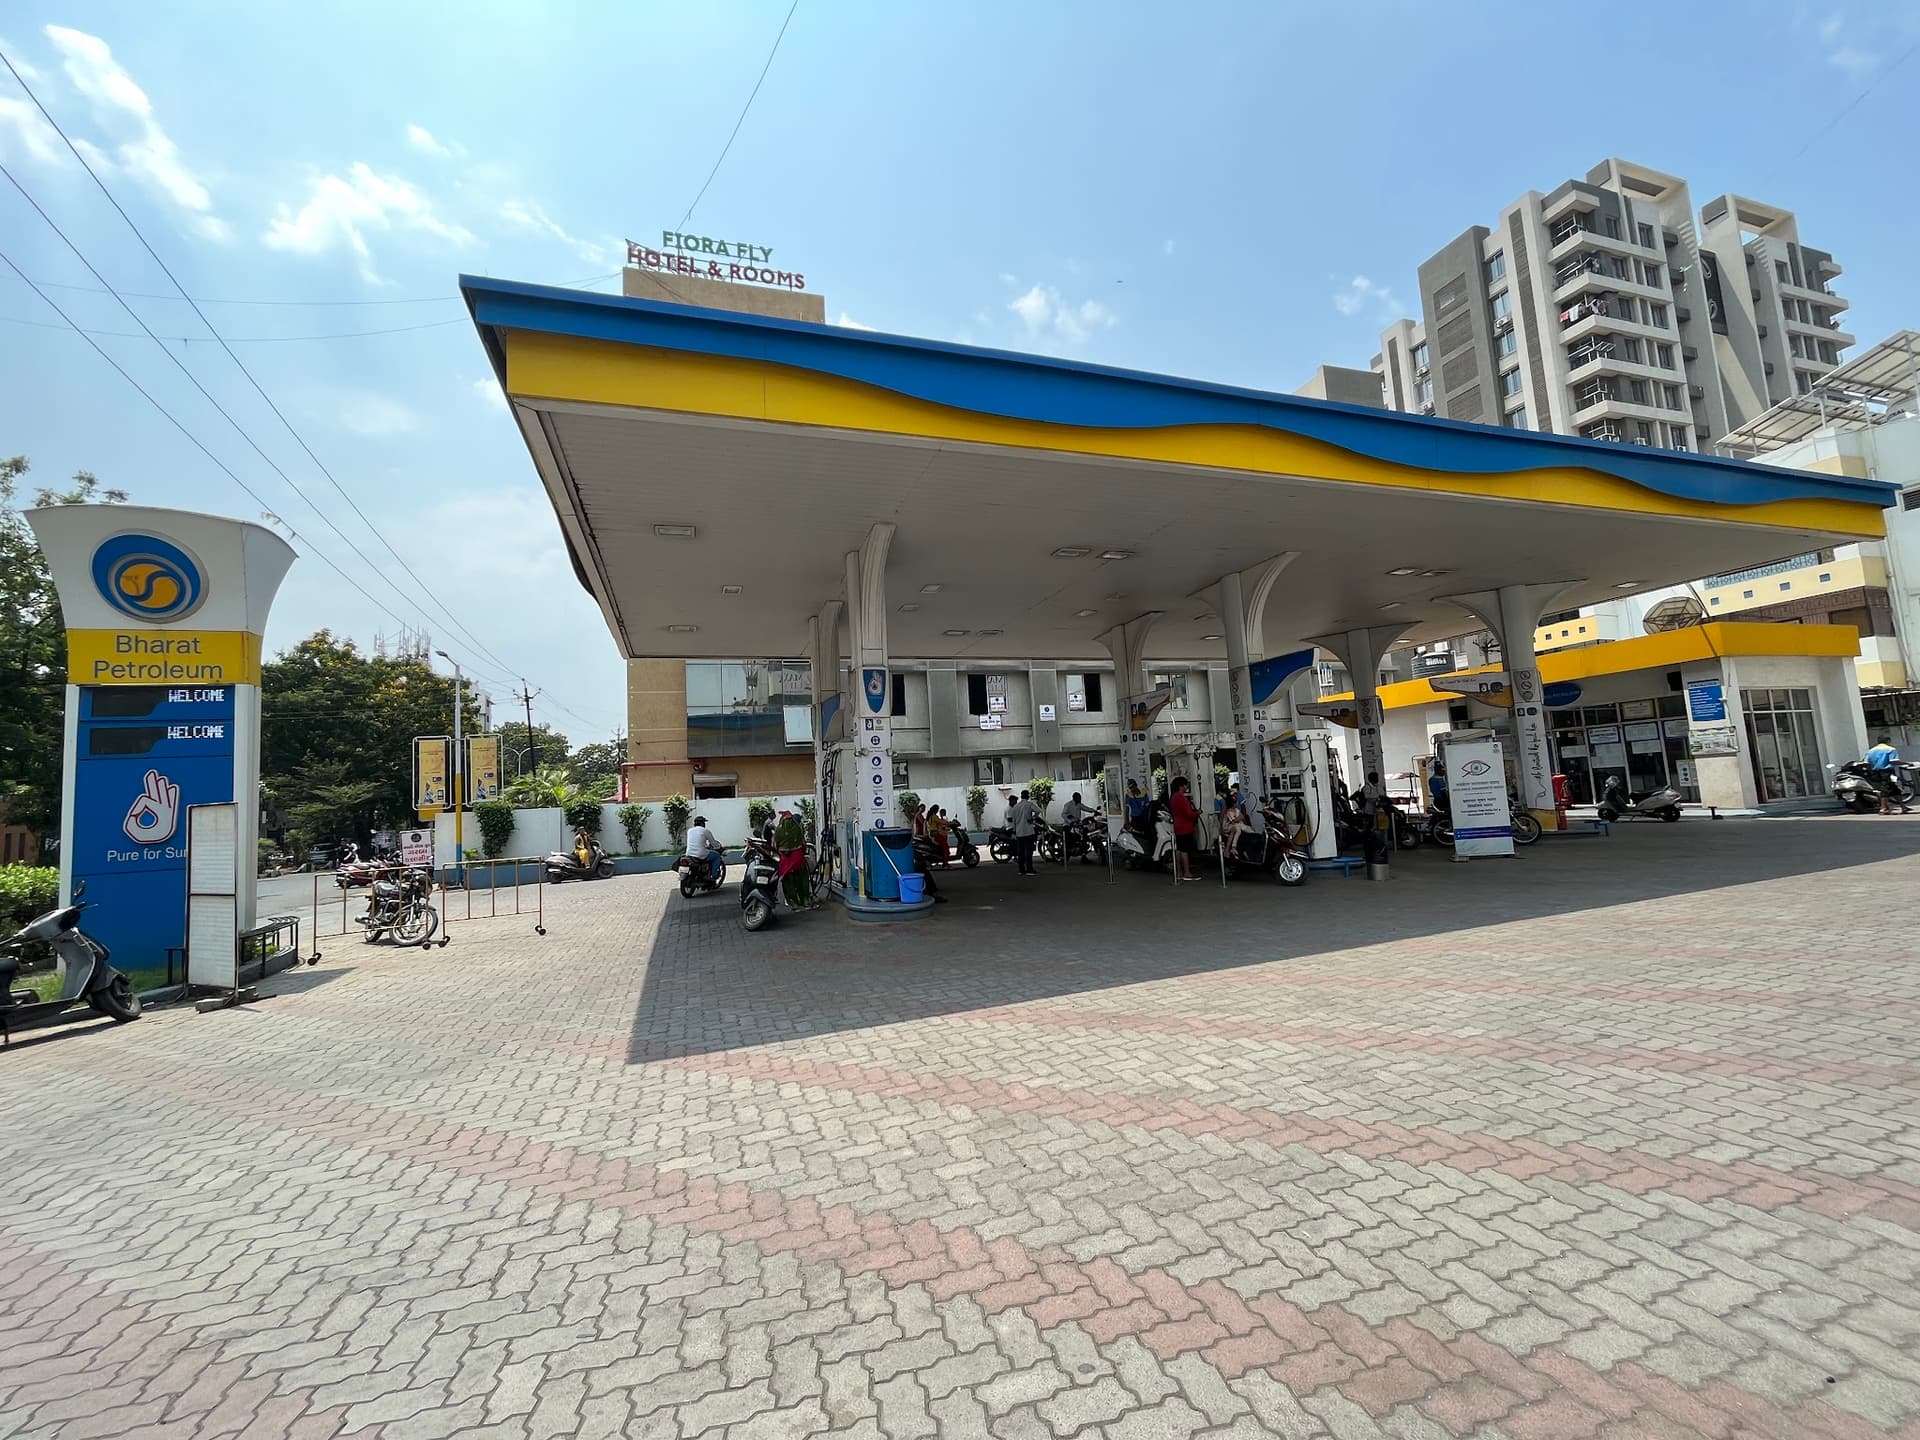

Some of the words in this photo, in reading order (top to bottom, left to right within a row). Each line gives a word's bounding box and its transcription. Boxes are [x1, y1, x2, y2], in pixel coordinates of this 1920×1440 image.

[663, 230, 730, 257] FIORA
[737, 242, 773, 263] FLY
[627, 246, 701, 274] HOTEL
[708, 260, 722, 278] &
[730, 263, 805, 290] ROOMS
[115, 635, 202, 655] Bharat
[94, 660, 223, 680] Petroleum
[168, 689, 225, 703] WELCOME
[167, 725, 225, 739] WELCOME
[107, 850, 139, 863] Pure
[143, 848, 162, 860] for
